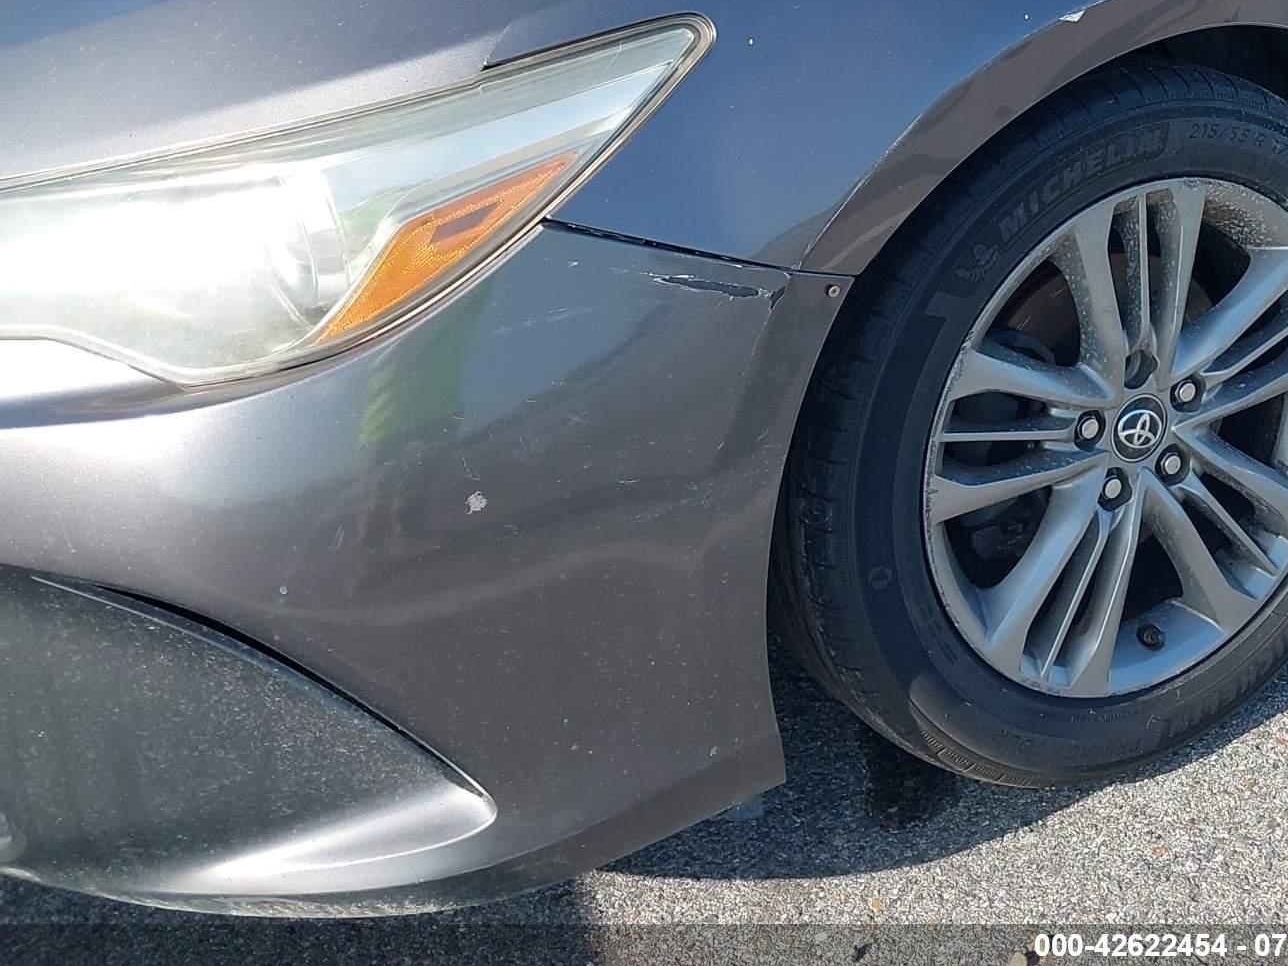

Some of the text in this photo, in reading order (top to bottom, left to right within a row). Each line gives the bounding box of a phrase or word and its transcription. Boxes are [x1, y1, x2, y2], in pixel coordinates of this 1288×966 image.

[1187, 121, 1252, 147] 215/55
[1252, 130, 1268, 150] R
[999, 124, 1167, 243] MICHELIN
